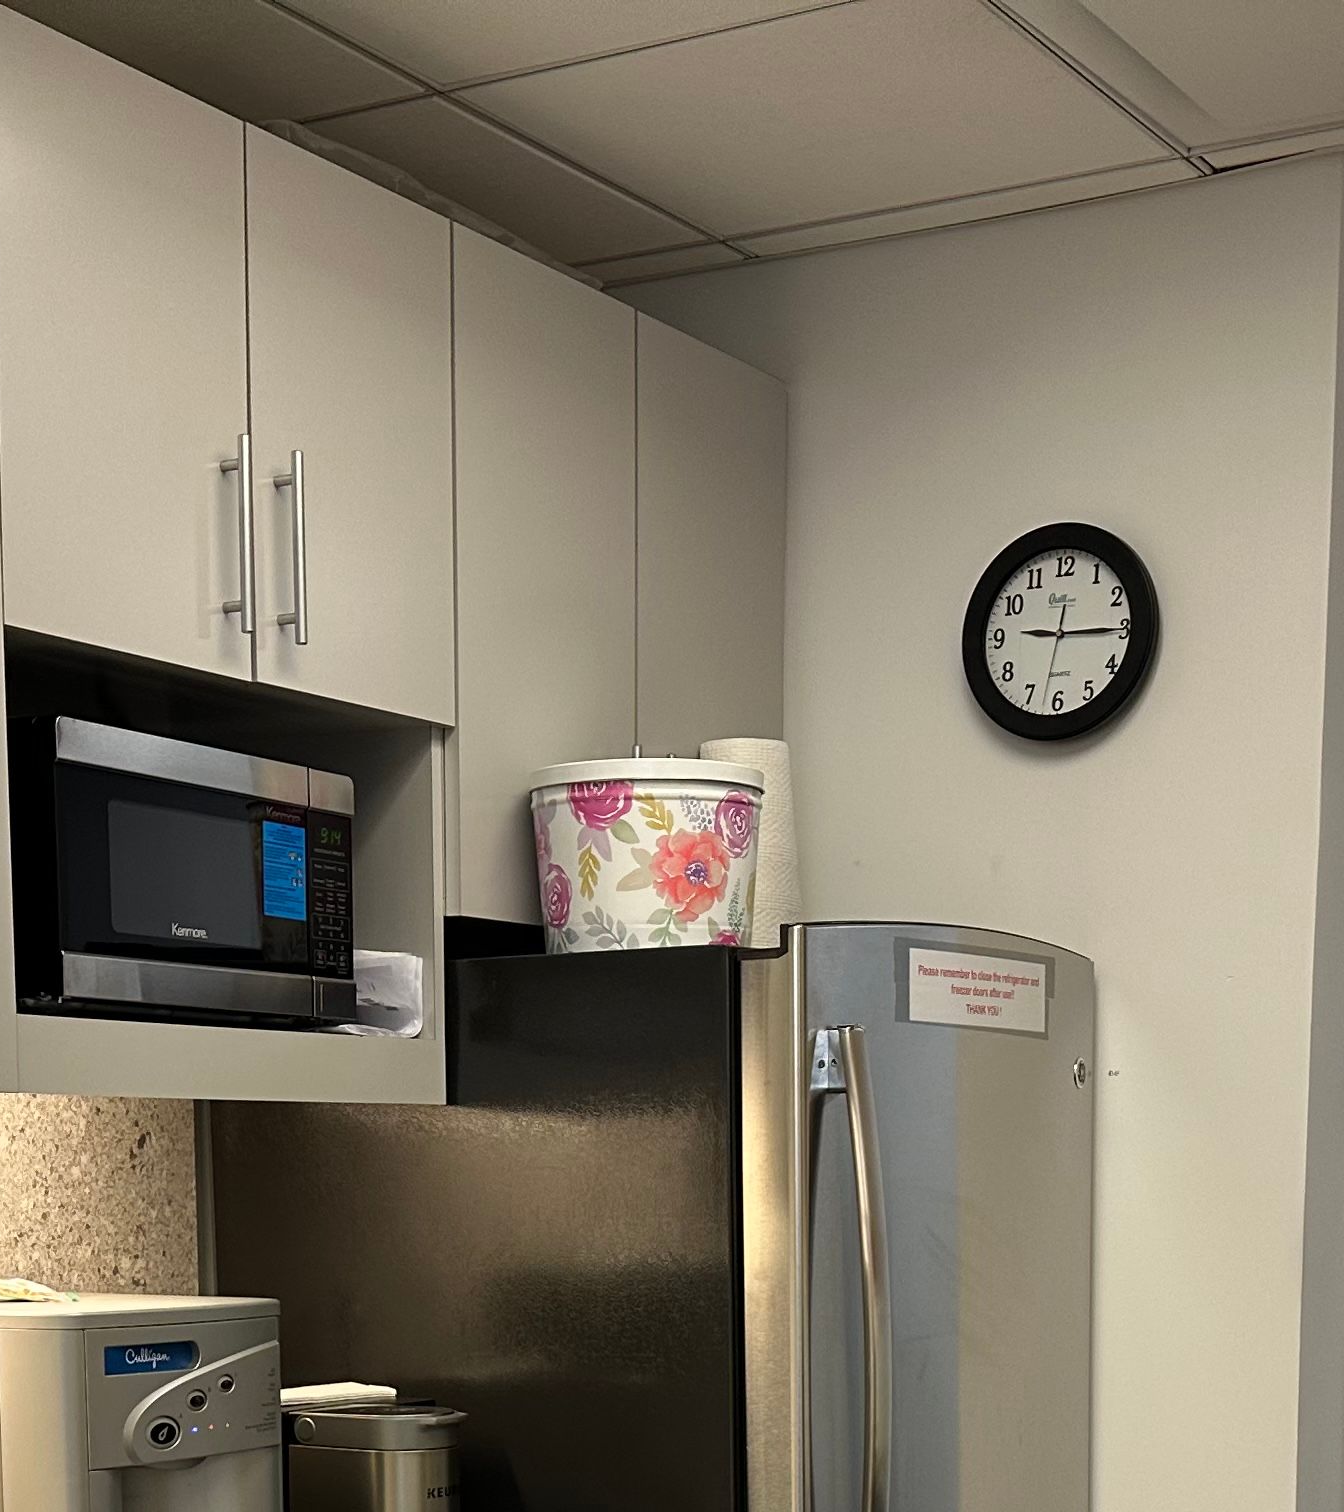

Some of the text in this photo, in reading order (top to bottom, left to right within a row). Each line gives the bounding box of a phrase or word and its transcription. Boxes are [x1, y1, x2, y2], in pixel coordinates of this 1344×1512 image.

[1055, 555, 1075, 577] 12
[1092, 563, 1100, 584] 1
[1026, 567, 1043, 589] 11
[1004, 593, 1024, 616] 10
[1111, 585, 1123, 607] 2
[993, 628, 1005, 649] 9
[1118, 618, 1130, 639] 3
[1001, 661, 1014, 682] 8
[1105, 653, 1118, 675] 4
[1024, 683, 1035, 705] 7
[1052, 690, 1064, 711] 6
[1082, 680, 1094, 701] 5
[918, 964, 939, 977] Please
[966, 1003, 986, 1015] THANK
[125, 1347, 170, 1369] Culligan
